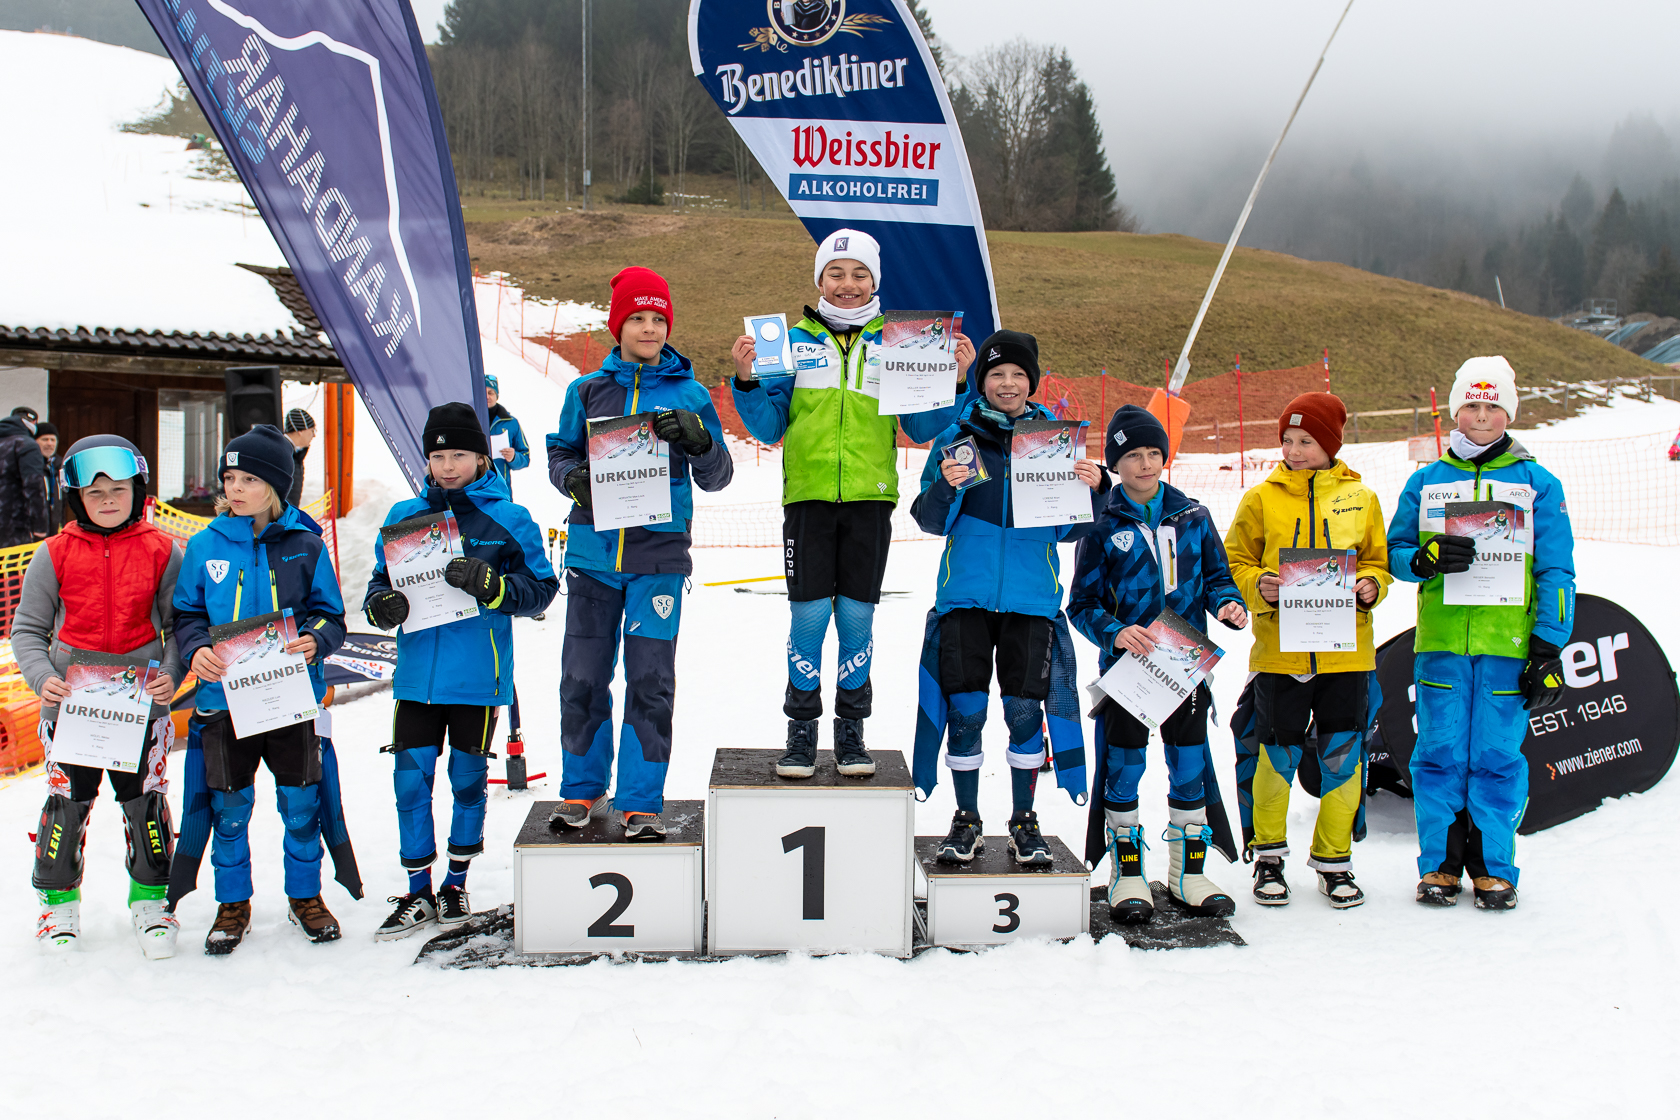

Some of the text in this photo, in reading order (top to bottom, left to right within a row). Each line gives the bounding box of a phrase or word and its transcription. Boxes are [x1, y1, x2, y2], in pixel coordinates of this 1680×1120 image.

[715, 53, 909, 115] Benediktiner
[791, 125, 941, 170] Weissbier
[798, 179, 928, 199] ALKOHOLFREI
[797, 345, 816, 353] EW
[885, 361, 957, 373] URKUNDE
[1465, 392, 1499, 401] Red Bull
[595, 466, 668, 484] URKUNDE
[1509, 490, 1531, 498] ARCO
[786, 538, 795, 577] EQPE
[1473, 552, 1523, 562] KUNDE
[395, 567, 446, 588] URKUN
[1284, 598, 1354, 609] URKUNDE
[228, 662, 306, 691] URKUNDE
[1130, 651, 1188, 699] URKUNDE
[65, 703, 146, 725] URKUNDE
[1529, 694, 1628, 737] EST. 1946
[1555, 737, 1643, 776] www.ziener.com
[48, 823, 63, 860] LEKI
[147, 820, 162, 854] LEKI
[1121, 854, 1139, 863] LINE
[1189, 851, 1205, 860] LINE
[781, 826, 826, 921] 1
[587, 872, 635, 938] 2
[992, 892, 1021, 934] 3
